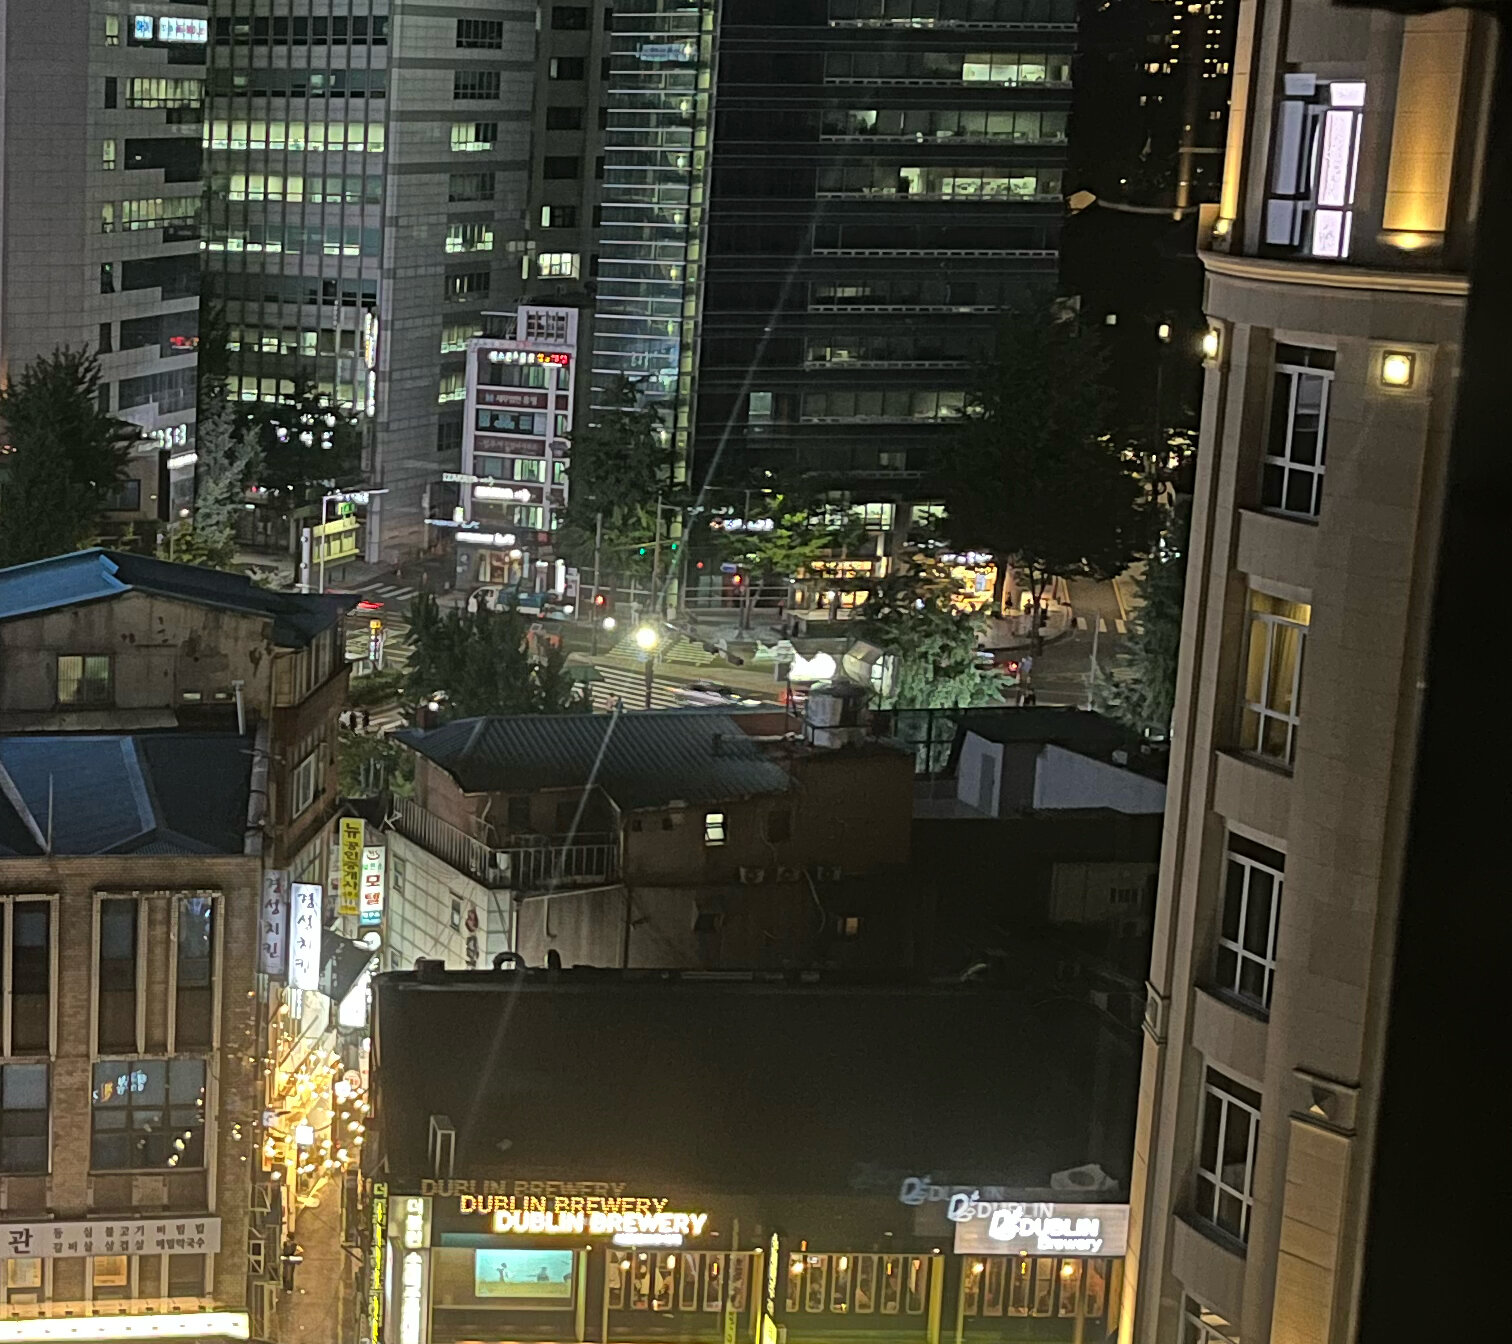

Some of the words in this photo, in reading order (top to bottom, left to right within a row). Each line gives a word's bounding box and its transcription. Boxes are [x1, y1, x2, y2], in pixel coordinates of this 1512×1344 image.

[364, 874, 381, 905] 모텔
[493, 1211, 584, 1233] DUBLIN
[588, 1213, 708, 1236] BREWERY
[1018, 1217, 1100, 1237] DUBLIN
